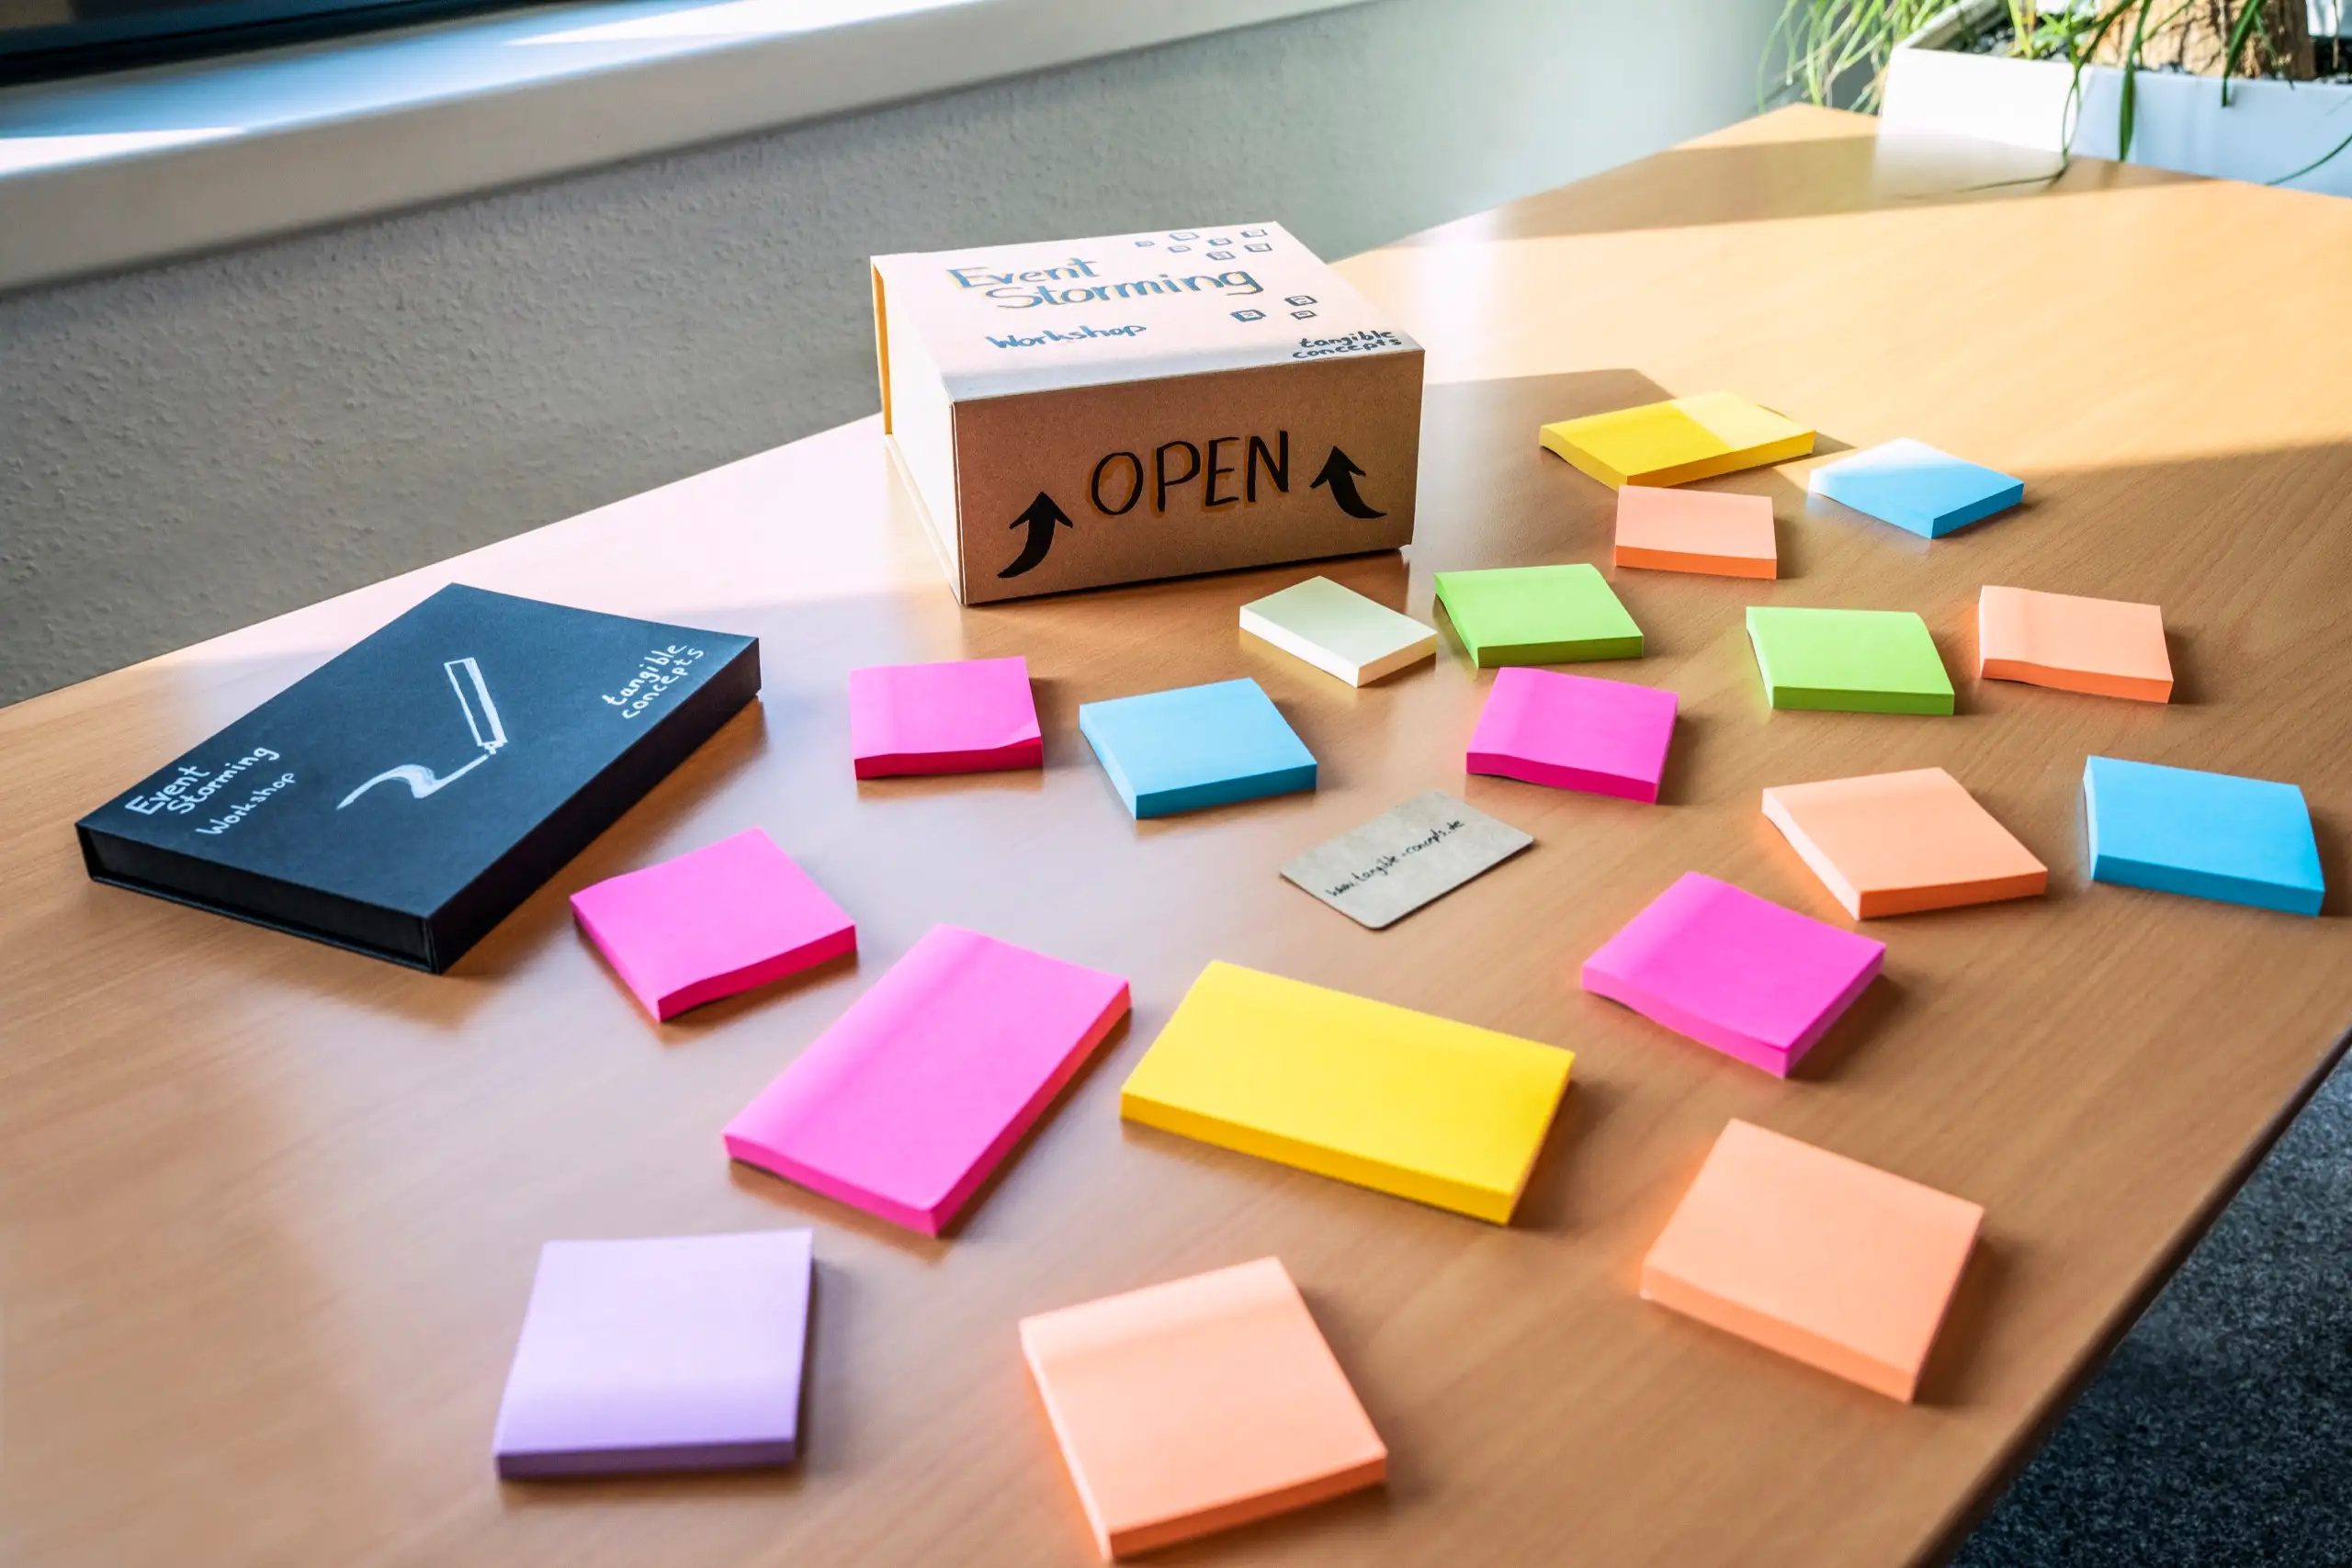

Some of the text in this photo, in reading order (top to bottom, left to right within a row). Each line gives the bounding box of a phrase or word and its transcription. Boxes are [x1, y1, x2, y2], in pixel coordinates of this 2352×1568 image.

[946, 257, 1101, 288] Event
[985, 270, 1264, 309] Storming
[985, 324, 1148, 349] Workshop
[1292, 338, 1402, 359] concepts
[1298, 330, 1395, 348] tangible
[1089, 430, 1289, 517] OPEN
[602, 645, 687, 705] tangible
[622, 649, 704, 718] concepts
[125, 765, 210, 815] Event
[166, 747, 280, 814] Storming
[195, 773, 296, 835] Workshop
